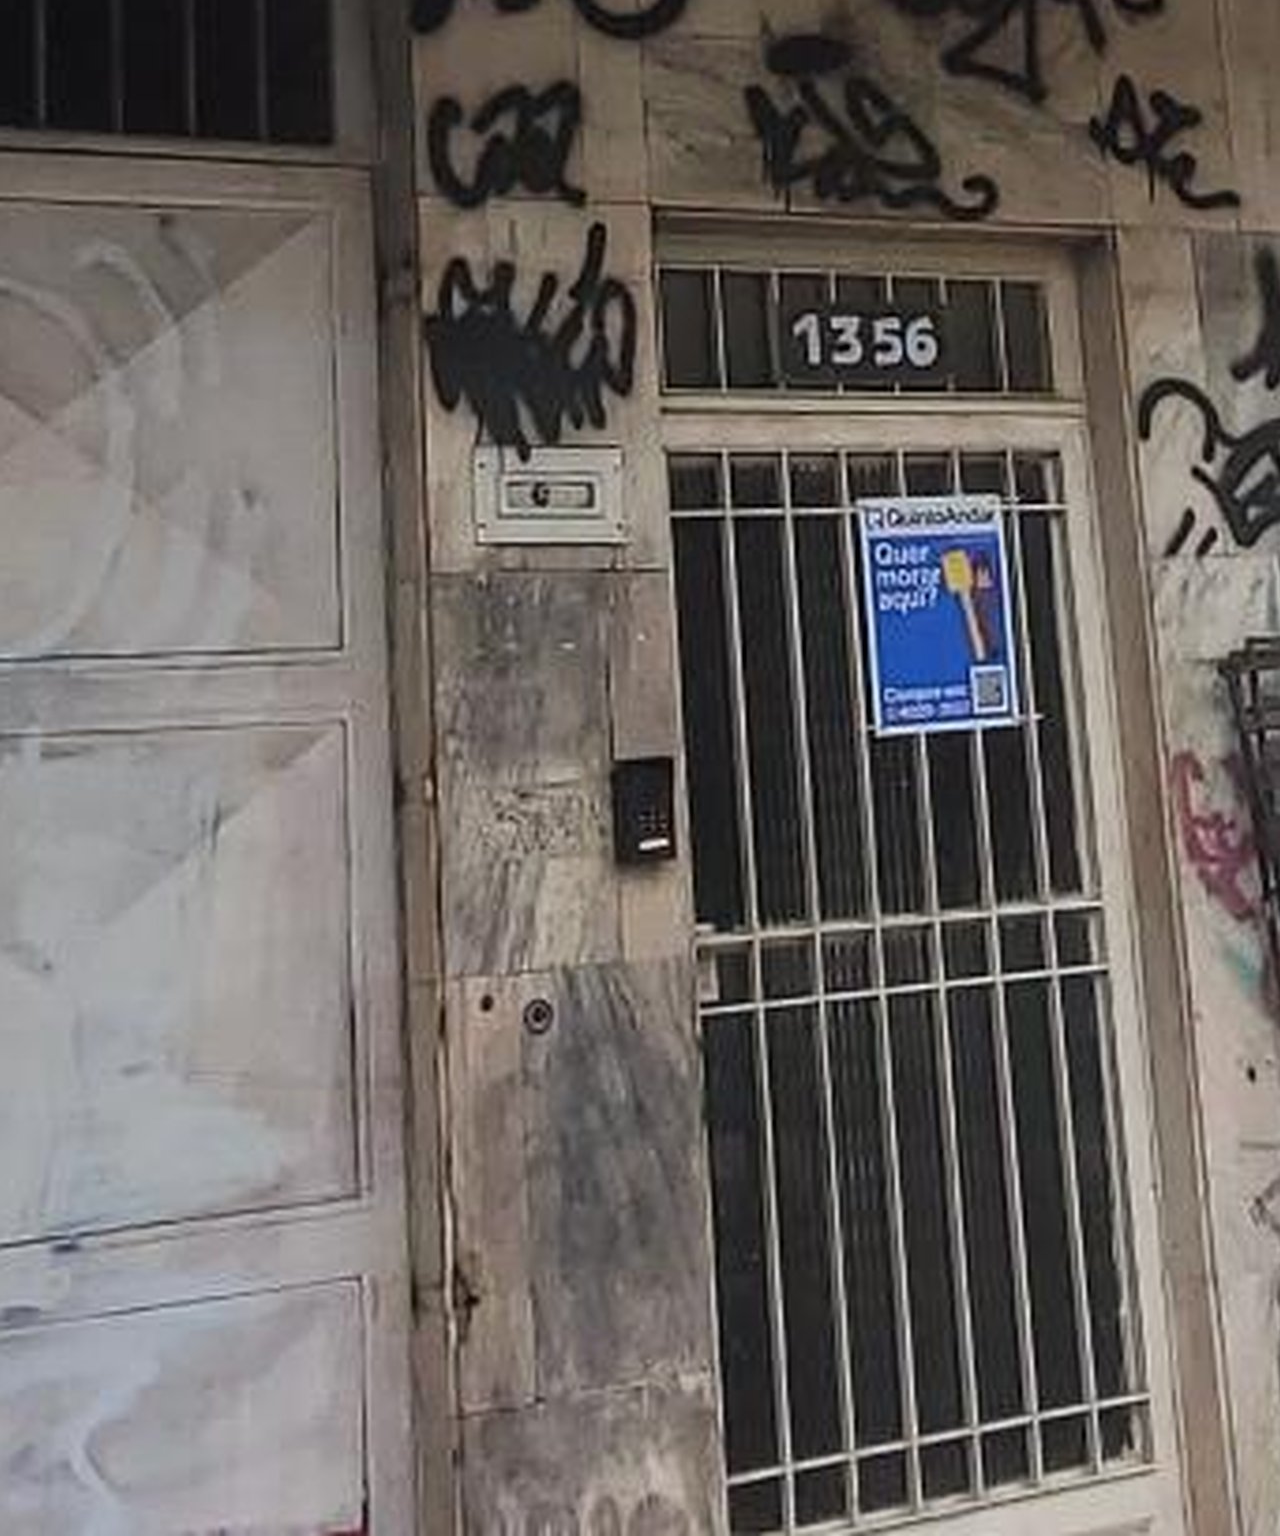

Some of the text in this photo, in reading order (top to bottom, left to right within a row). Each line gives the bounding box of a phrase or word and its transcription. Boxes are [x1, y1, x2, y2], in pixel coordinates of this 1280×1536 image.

[792, 312, 939, 368] 1356
[875, 542, 932, 566] Quer
[879, 587, 939, 615] aqui?
